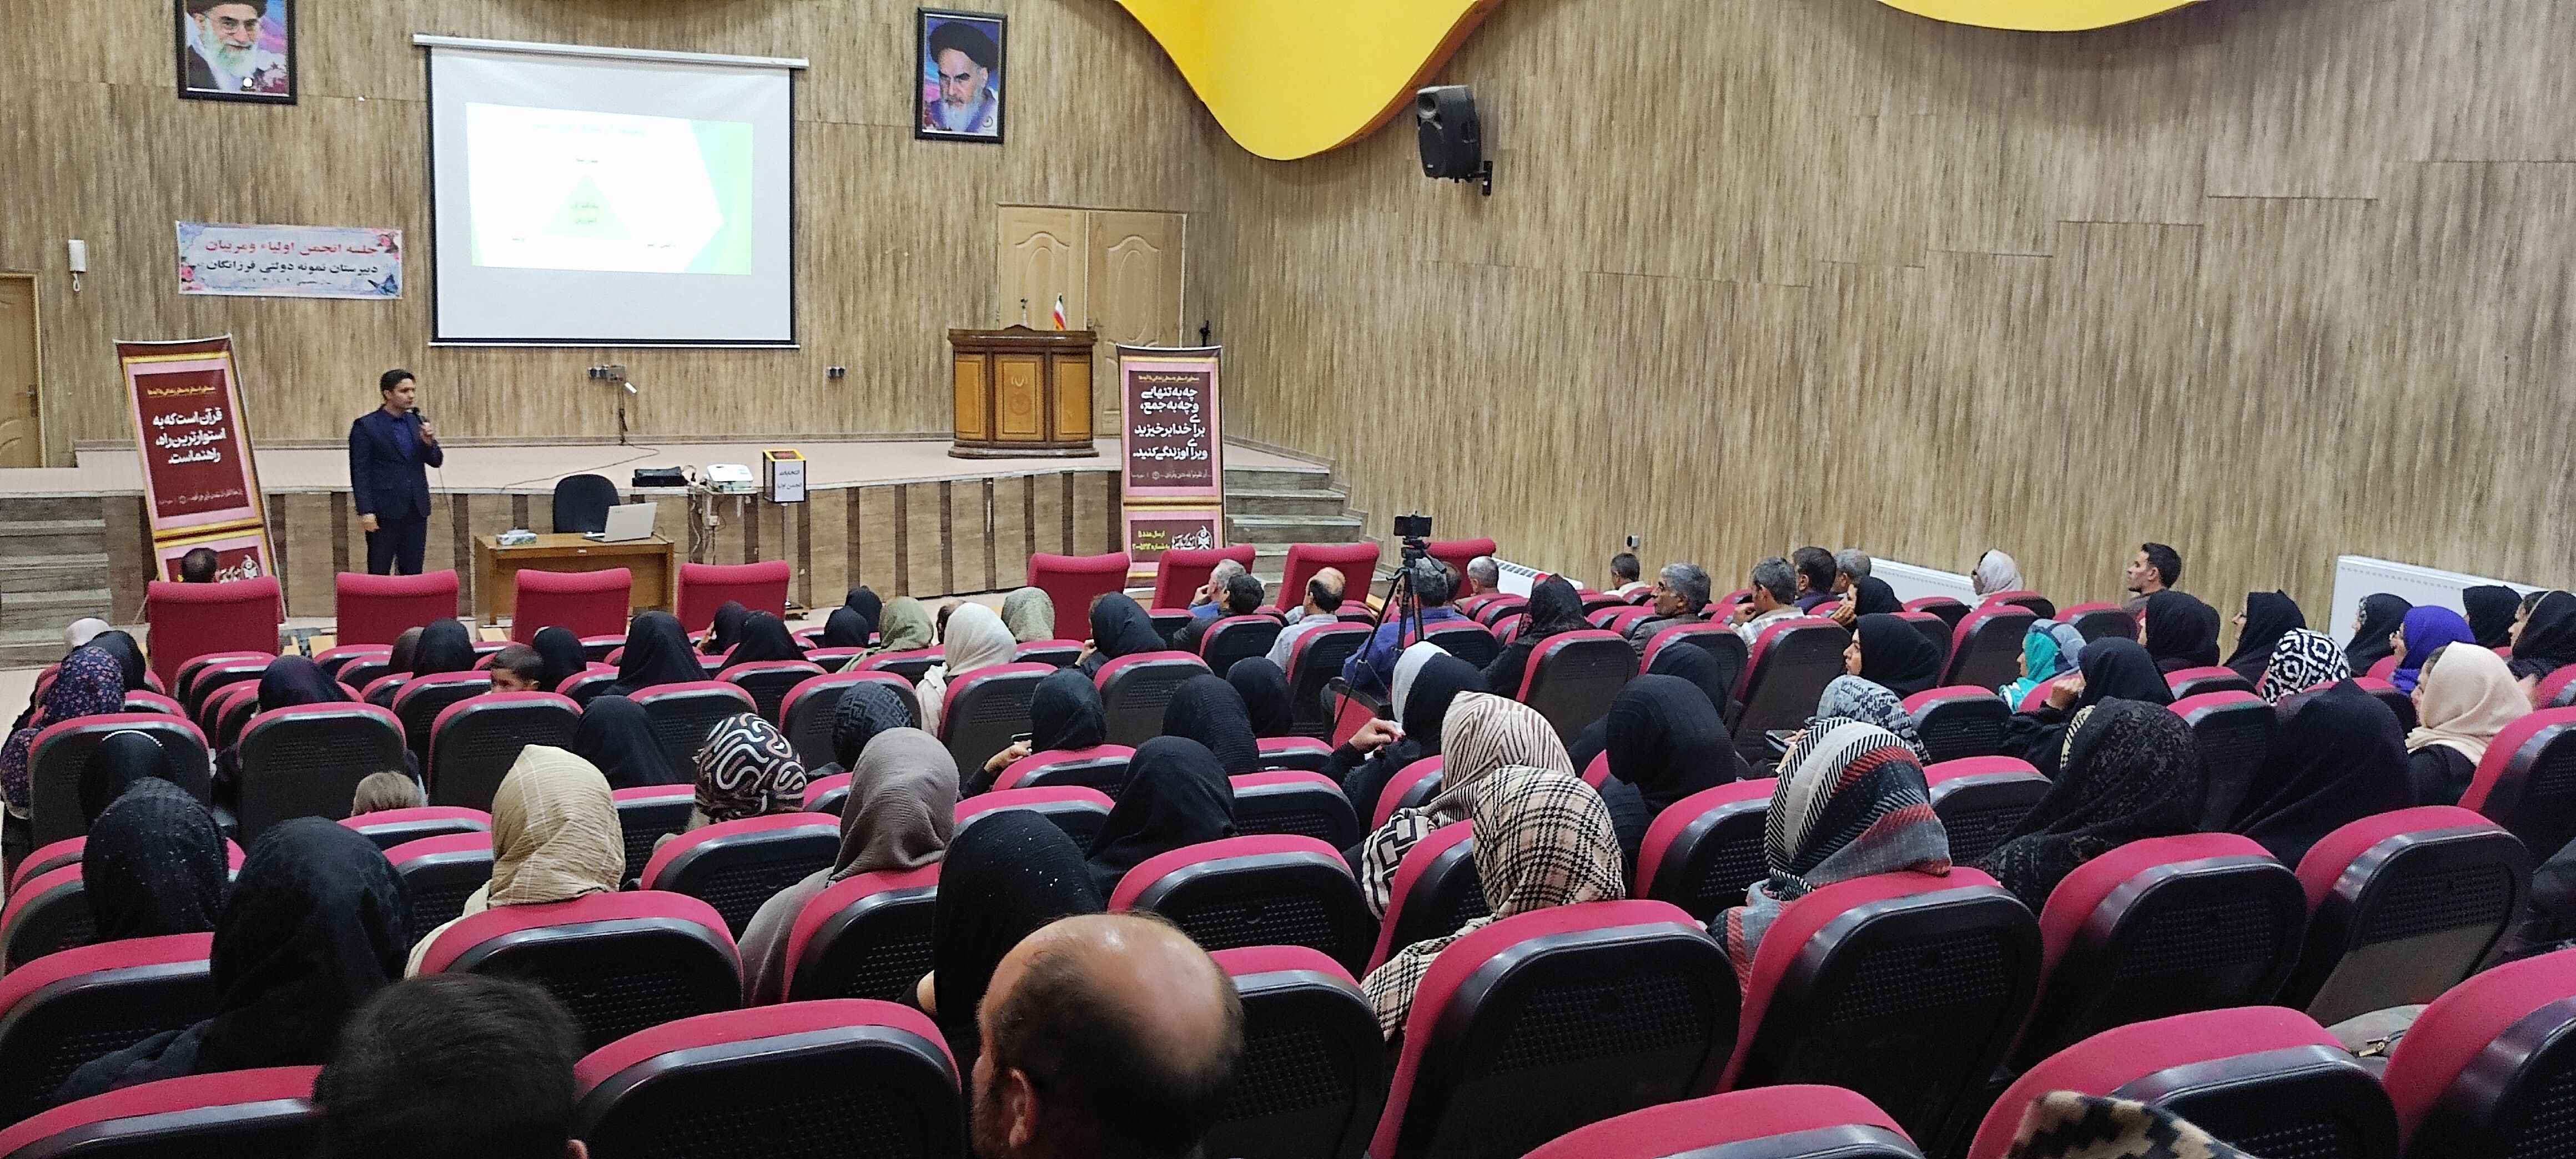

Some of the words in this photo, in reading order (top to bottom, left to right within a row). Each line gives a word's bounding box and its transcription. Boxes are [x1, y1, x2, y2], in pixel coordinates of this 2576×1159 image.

[299, 244, 342, 256] انجمن
[346, 245, 379, 256] جلسه
[206, 260, 255, 273] فرزانگان
[259, 261, 294, 273] دولتی
[298, 263, 326, 275] نمونه
[329, 264, 378, 276] دبیرستان
[1141, 386, 1172, 400] تنهایی
[1172, 387, 1183, 400] به
[1183, 387, 1198, 402] چه
[1166, 400, 1178, 414] به
[1177, 400, 1193, 415] چه
[153, 415, 165, 430] به
[164, 412, 177, 425] که
[175, 411, 200, 425] است
[199, 407, 223, 426] قرآن
[1172, 422, 1192, 435] خدا
[1155, 445, 1182, 460] زندگی
